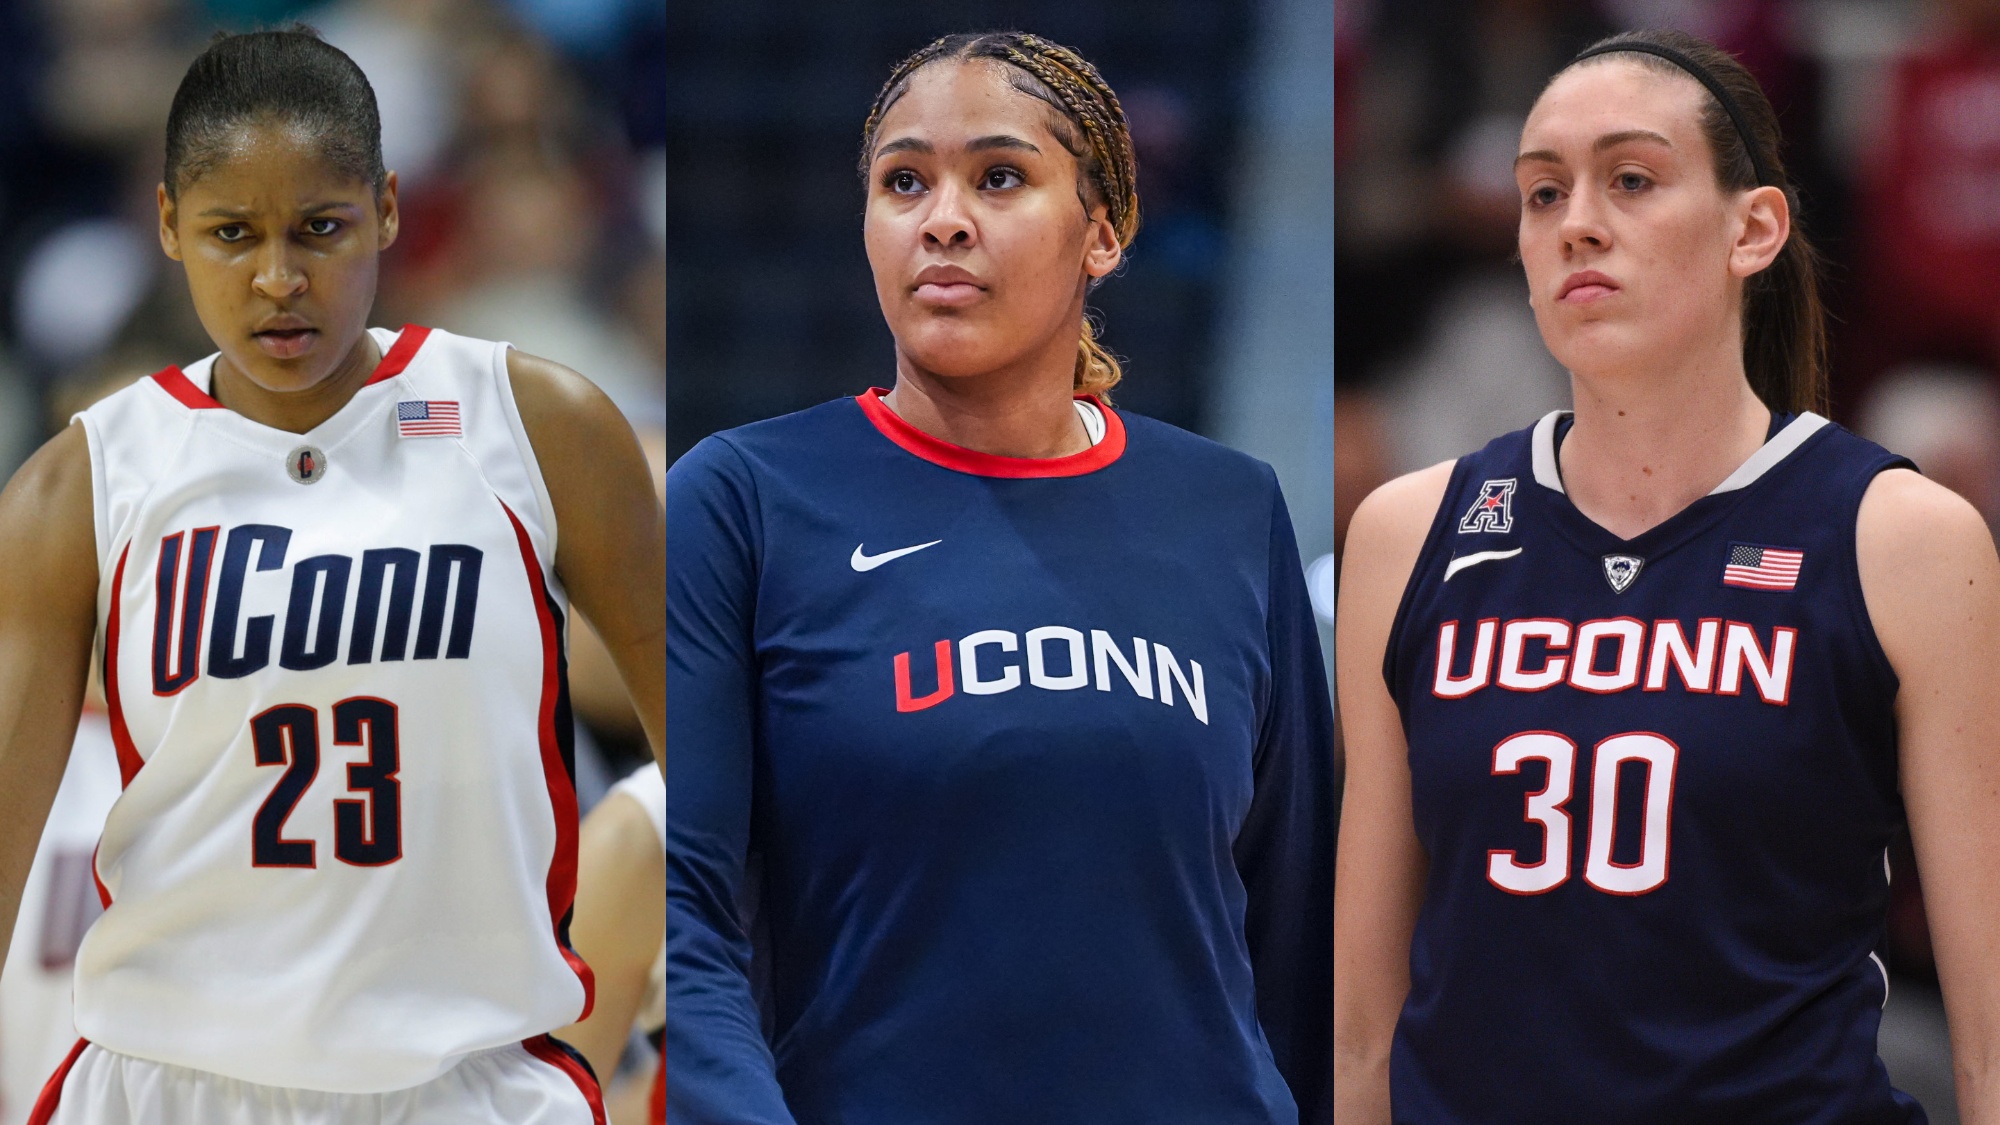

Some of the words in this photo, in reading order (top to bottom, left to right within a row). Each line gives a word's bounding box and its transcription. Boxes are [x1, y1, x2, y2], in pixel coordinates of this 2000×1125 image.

[894, 626, 1209, 726] UCONN
[1431, 616, 1798, 706] UCONN
[250, 696, 403, 868] 23
[1486, 730, 1679, 896] 30
